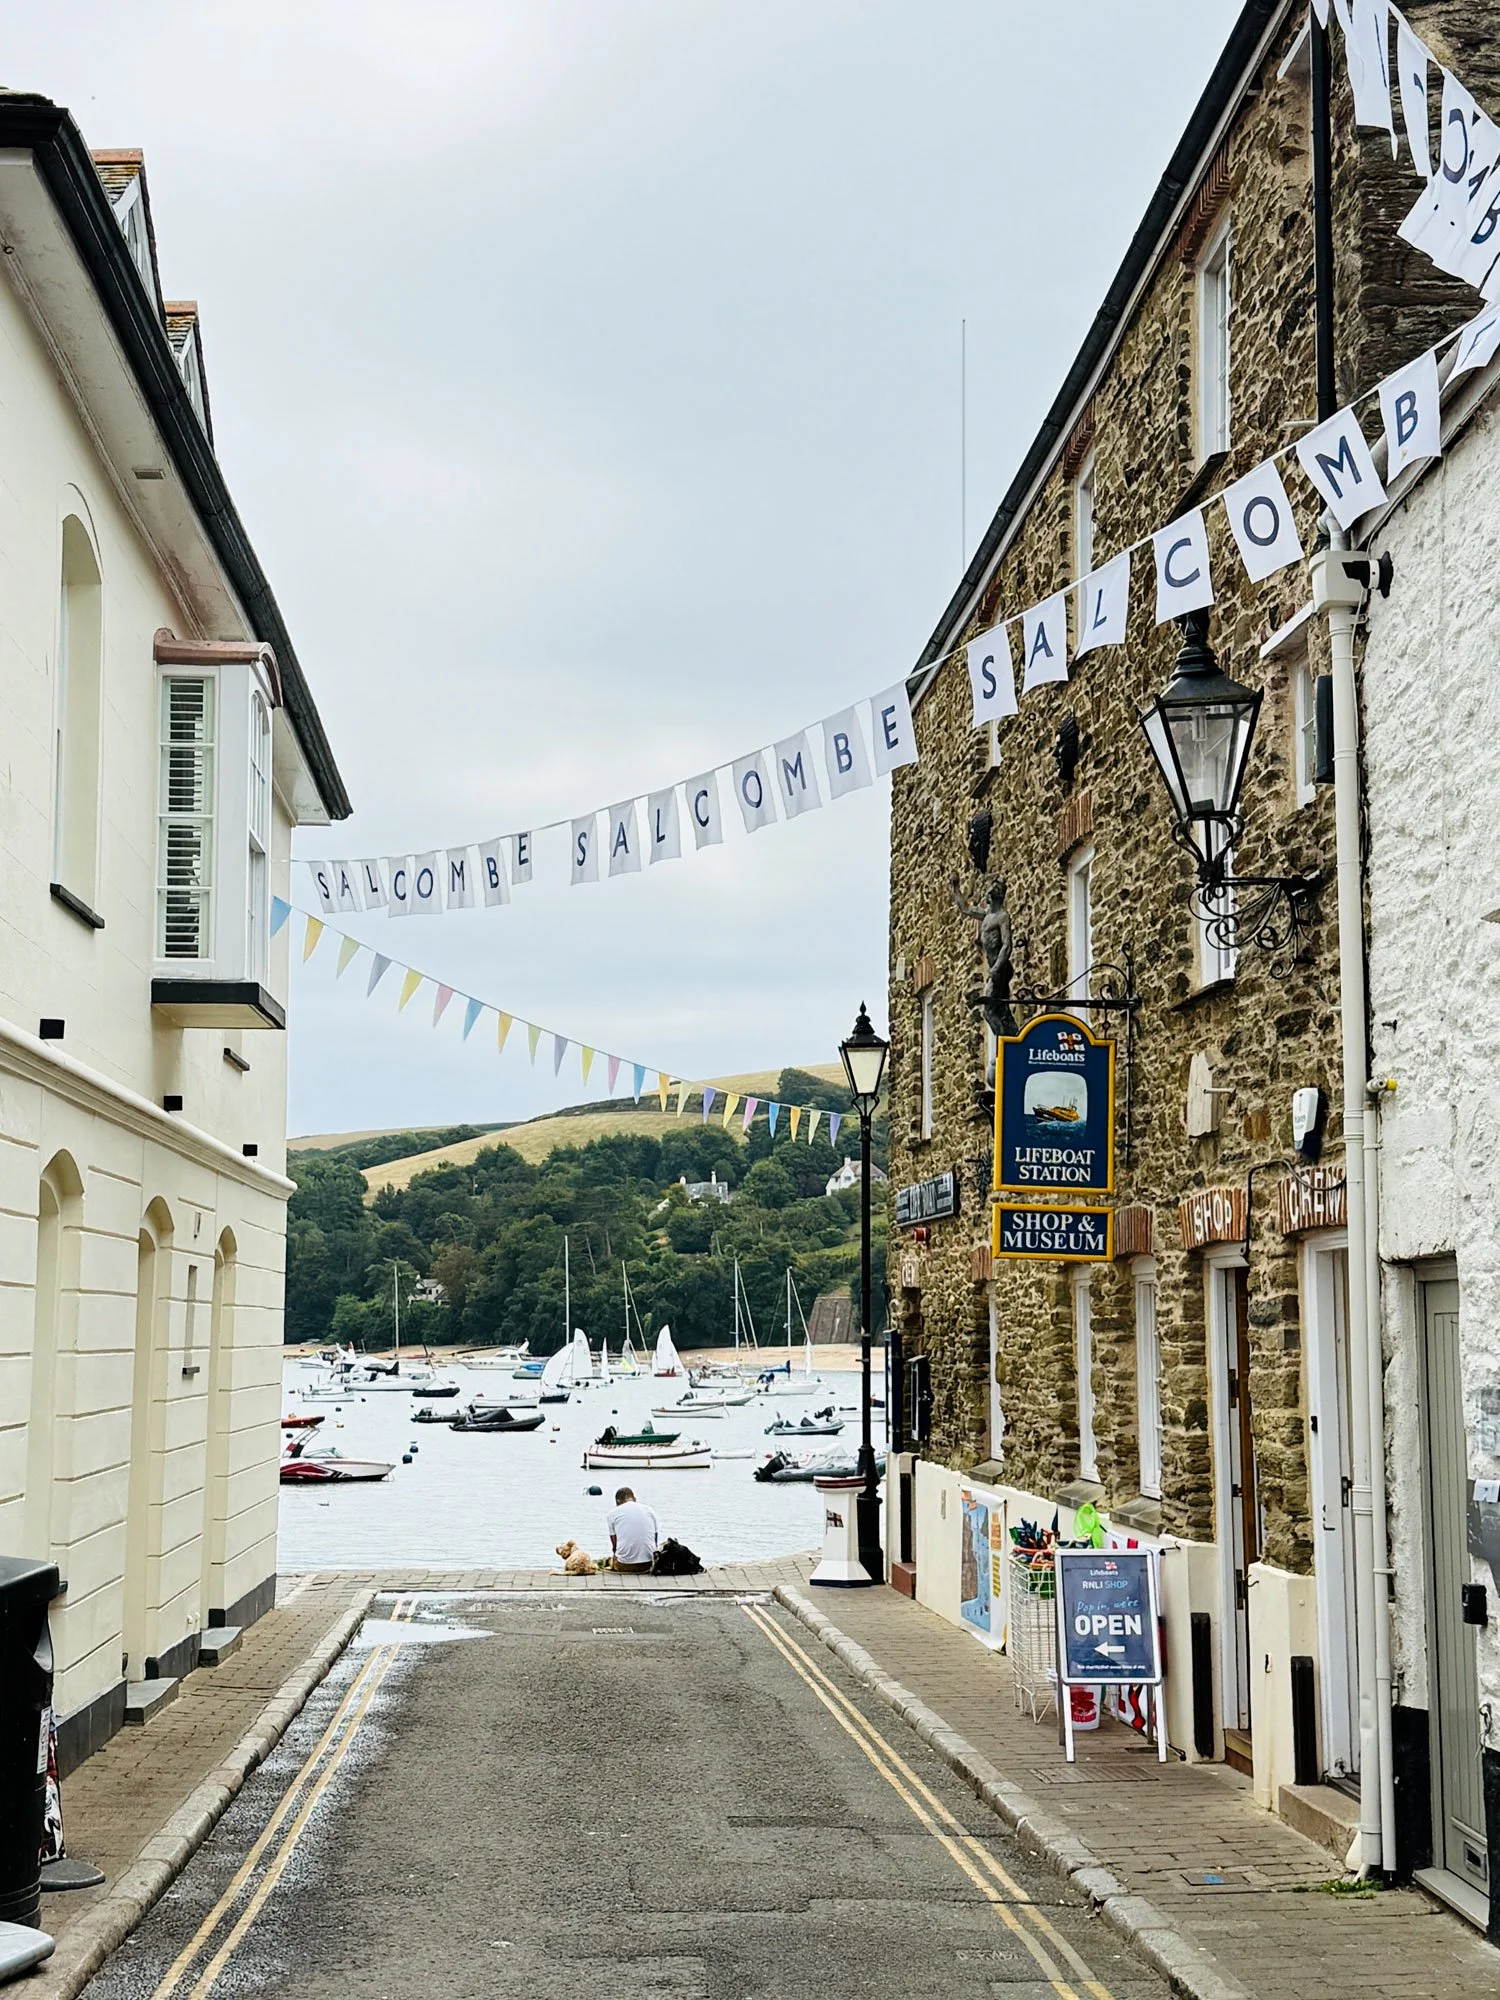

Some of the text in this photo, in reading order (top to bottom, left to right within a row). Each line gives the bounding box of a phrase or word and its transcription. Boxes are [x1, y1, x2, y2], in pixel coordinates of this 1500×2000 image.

[317, 834, 529, 900] SALCOMBE
[576, 704, 899, 867] SALCOMBE
[1028, 1048, 1086, 1063] Lifeboats
[1015, 1147, 1095, 1165] LIFEBOAT
[1019, 1165, 1091, 1182] STATION
[1289, 1172, 1342, 1226] CREW
[1012, 1213, 1095, 1232] SHOP &
[1194, 1193, 1232, 1241] SHOP
[1003, 1231, 1105, 1250] MUSEUM
[1082, 1580, 1128, 1589] RNLI SHOP
[1077, 1601, 1094, 1614] Pop
[1074, 1614, 1142, 1636] OPEN
